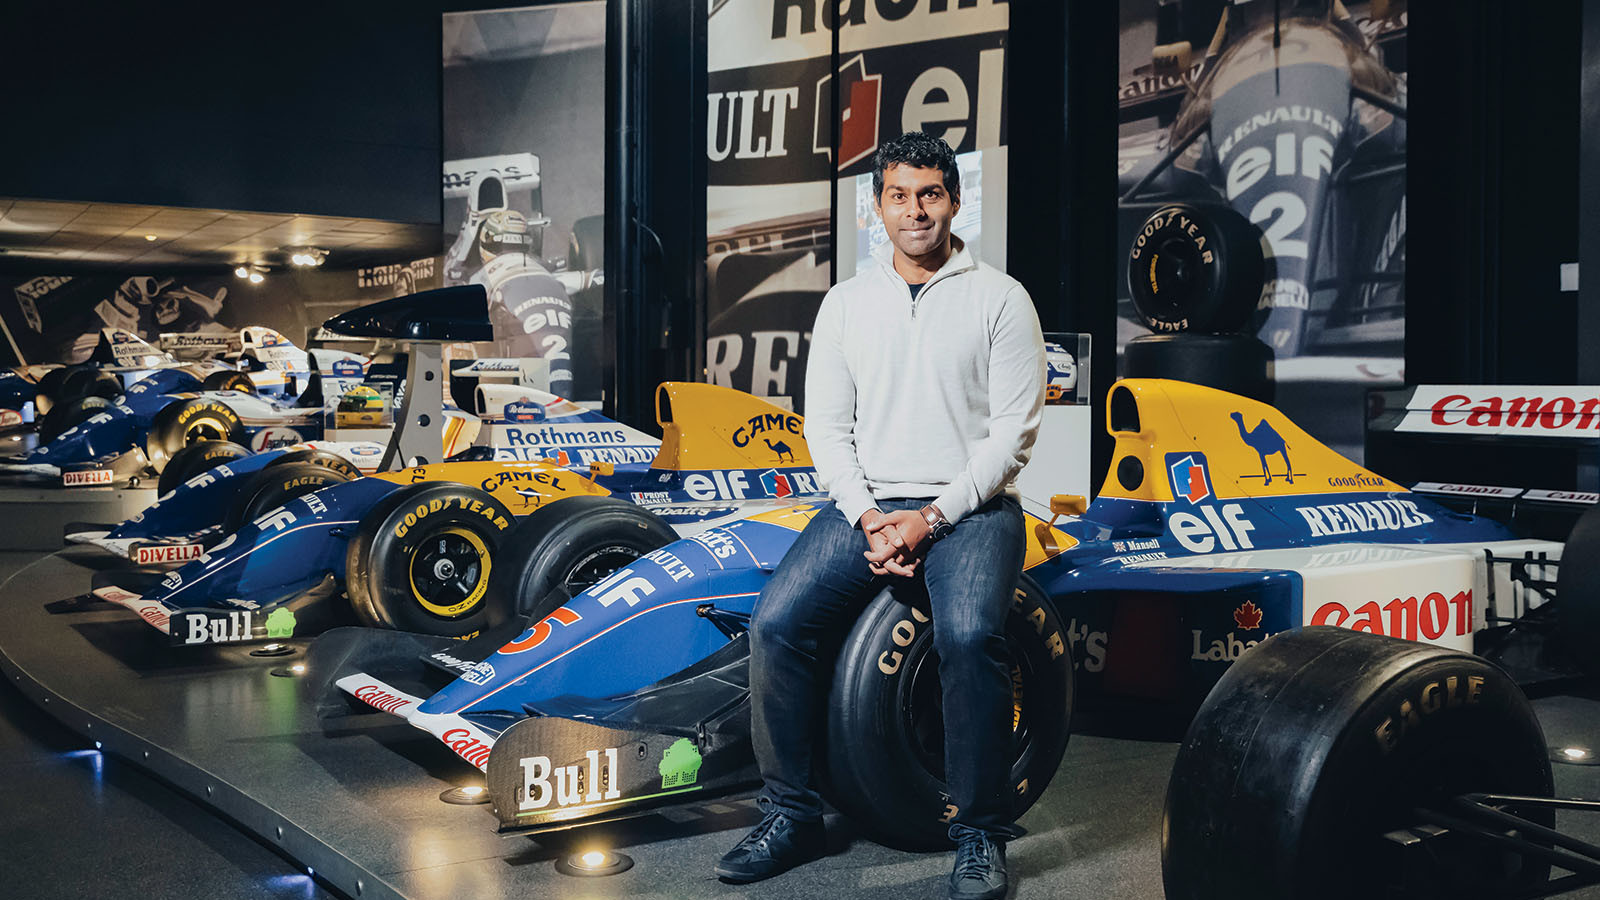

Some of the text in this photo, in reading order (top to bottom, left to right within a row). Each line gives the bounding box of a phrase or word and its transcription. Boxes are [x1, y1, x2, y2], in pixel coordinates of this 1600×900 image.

[1218, 105, 1344, 165] RENAULT
[1226, 132, 1336, 201] elf
[1250, 191, 1308, 259] 2
[506, 428, 627, 447] Rothmans
[732, 413, 806, 448] CAME
[65, 474, 111, 484] DIVELLA
[284, 476, 325, 490] EAGLE
[481, 471, 567, 493] CAMEL
[684, 470, 750, 501] elf
[643, 491, 669, 499] PROST
[1168, 503, 1256, 554] elf
[1296, 500, 1435, 538] RENAULT
[139, 546, 203, 563] DIVELLA
[1119, 551, 1168, 565] RENAULT
[1127, 538, 1161, 552] Mansell
[186, 612, 253, 644] Bull
[519, 748, 620, 811] Bull
